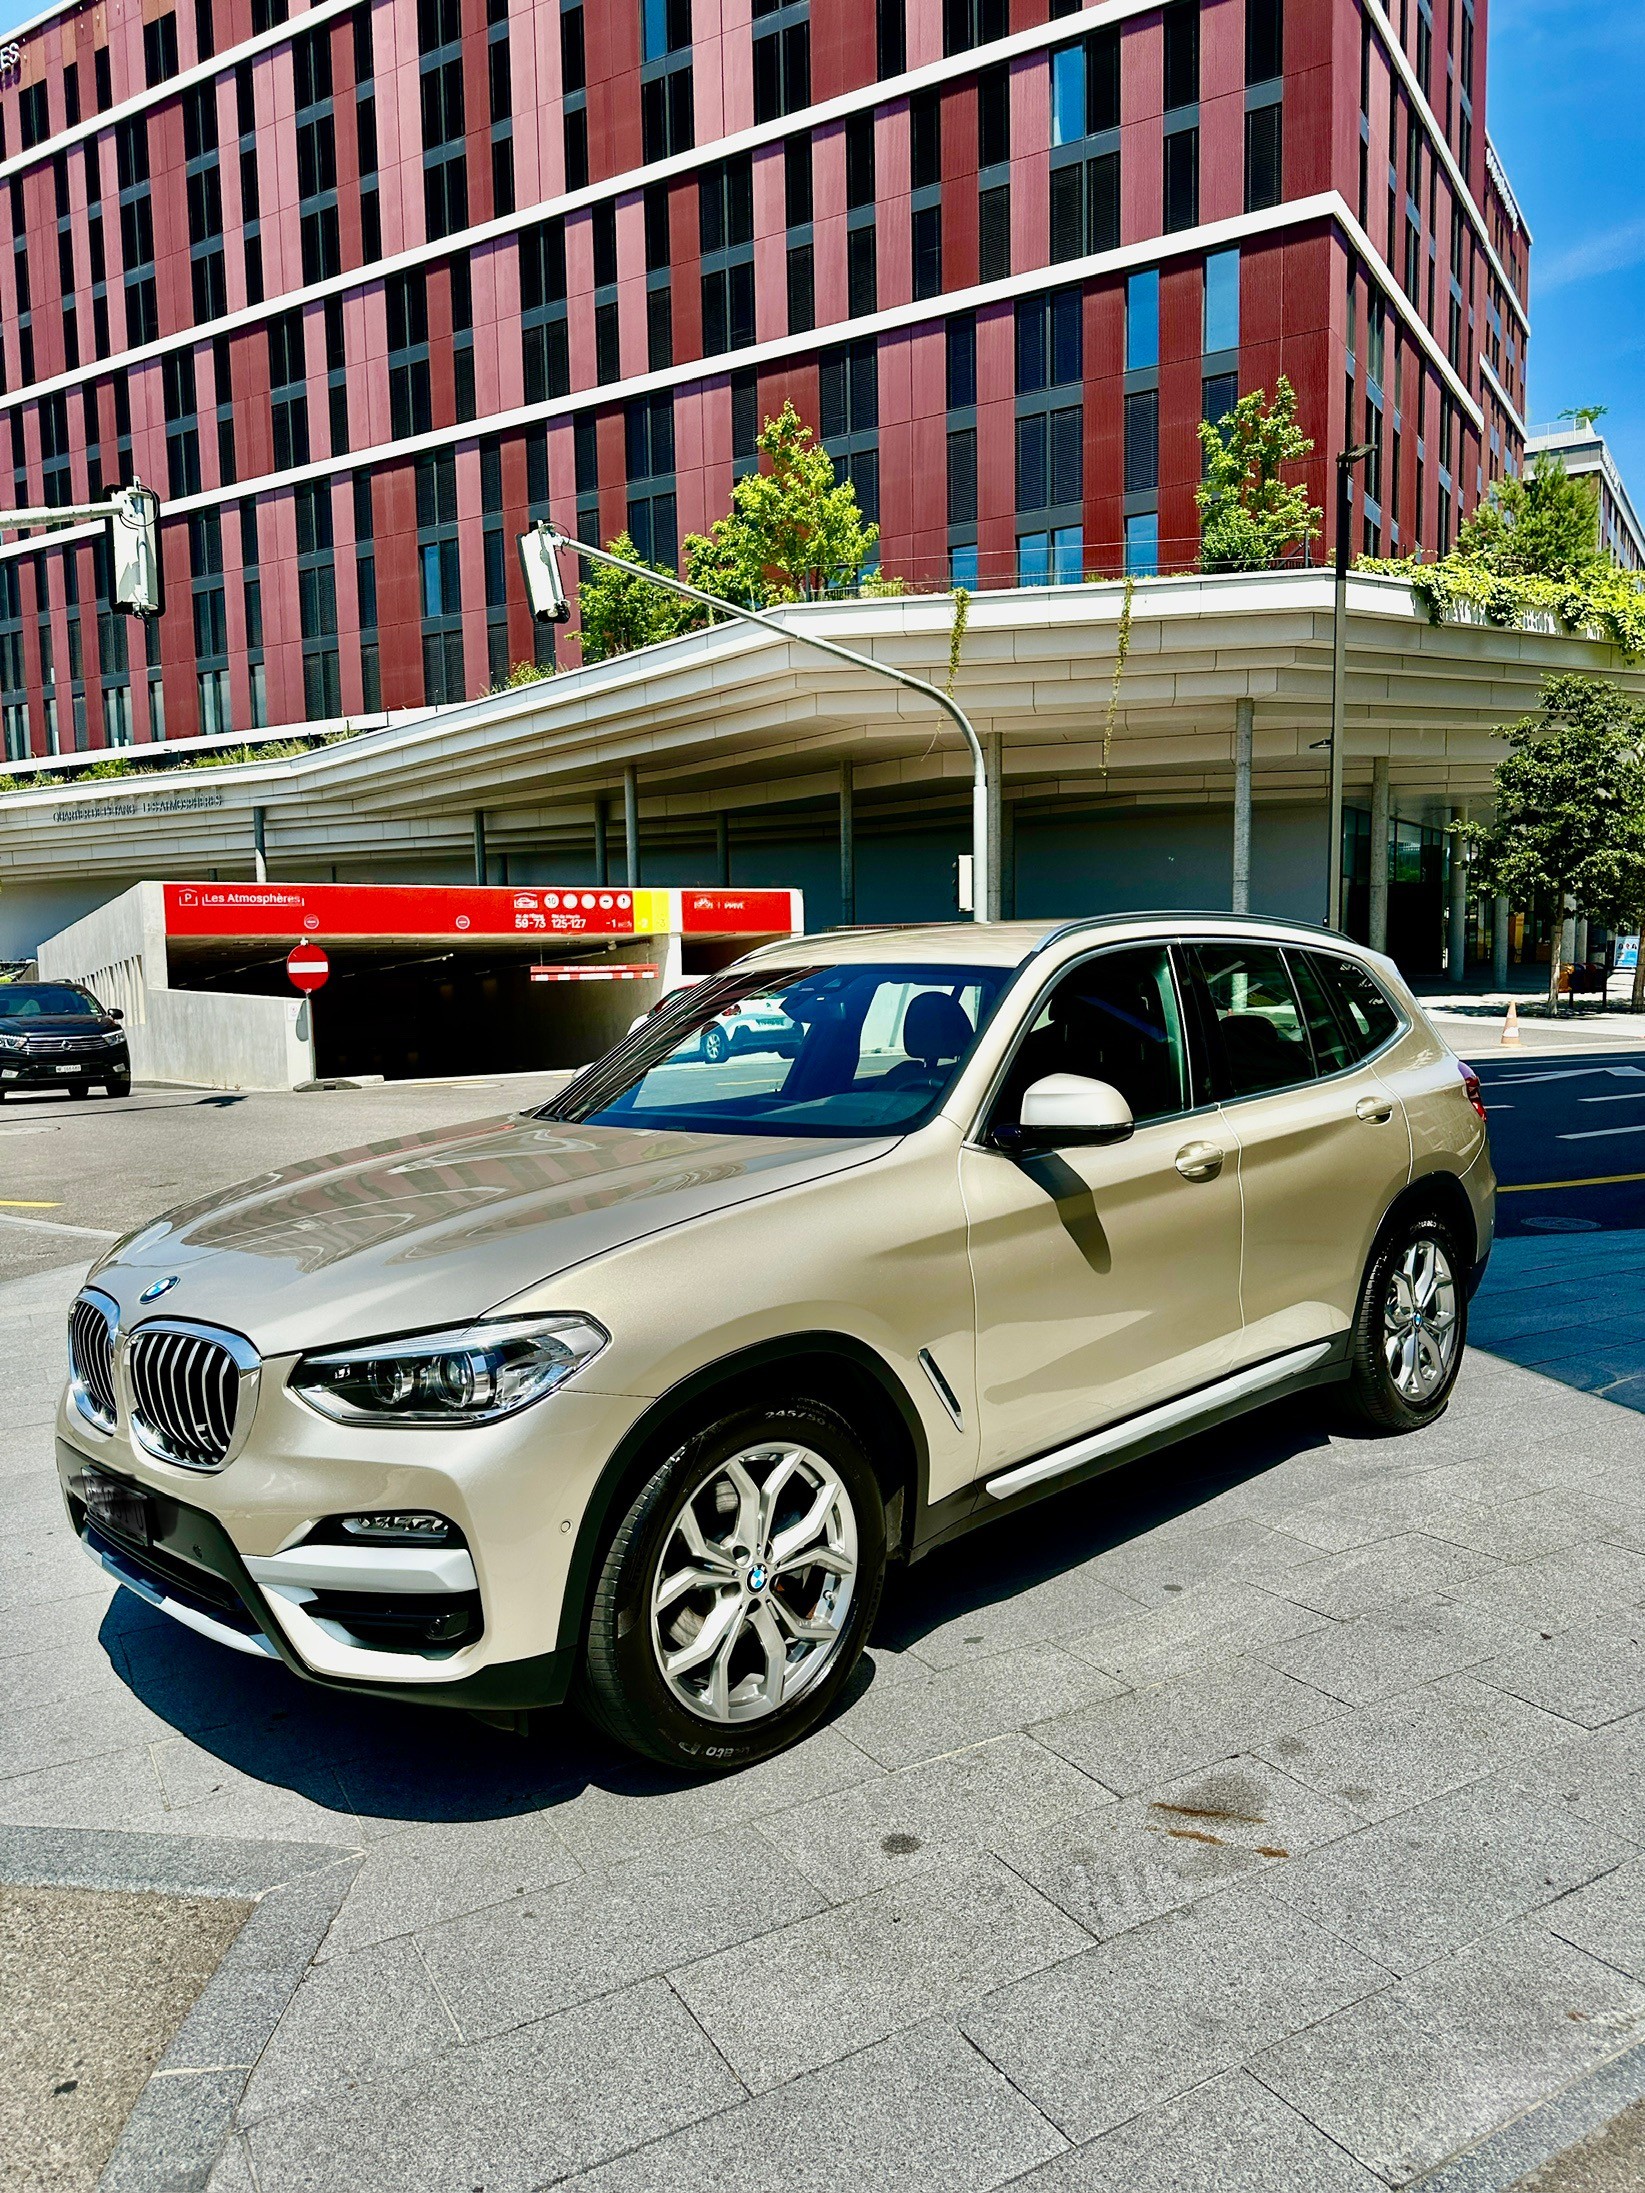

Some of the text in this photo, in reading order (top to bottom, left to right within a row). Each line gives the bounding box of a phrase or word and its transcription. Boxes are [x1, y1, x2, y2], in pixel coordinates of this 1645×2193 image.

[0, 42, 20, 72] ES
[205, 893, 301, 905] Les Atmosphères
[551, 918, 587, 929] 125-127
